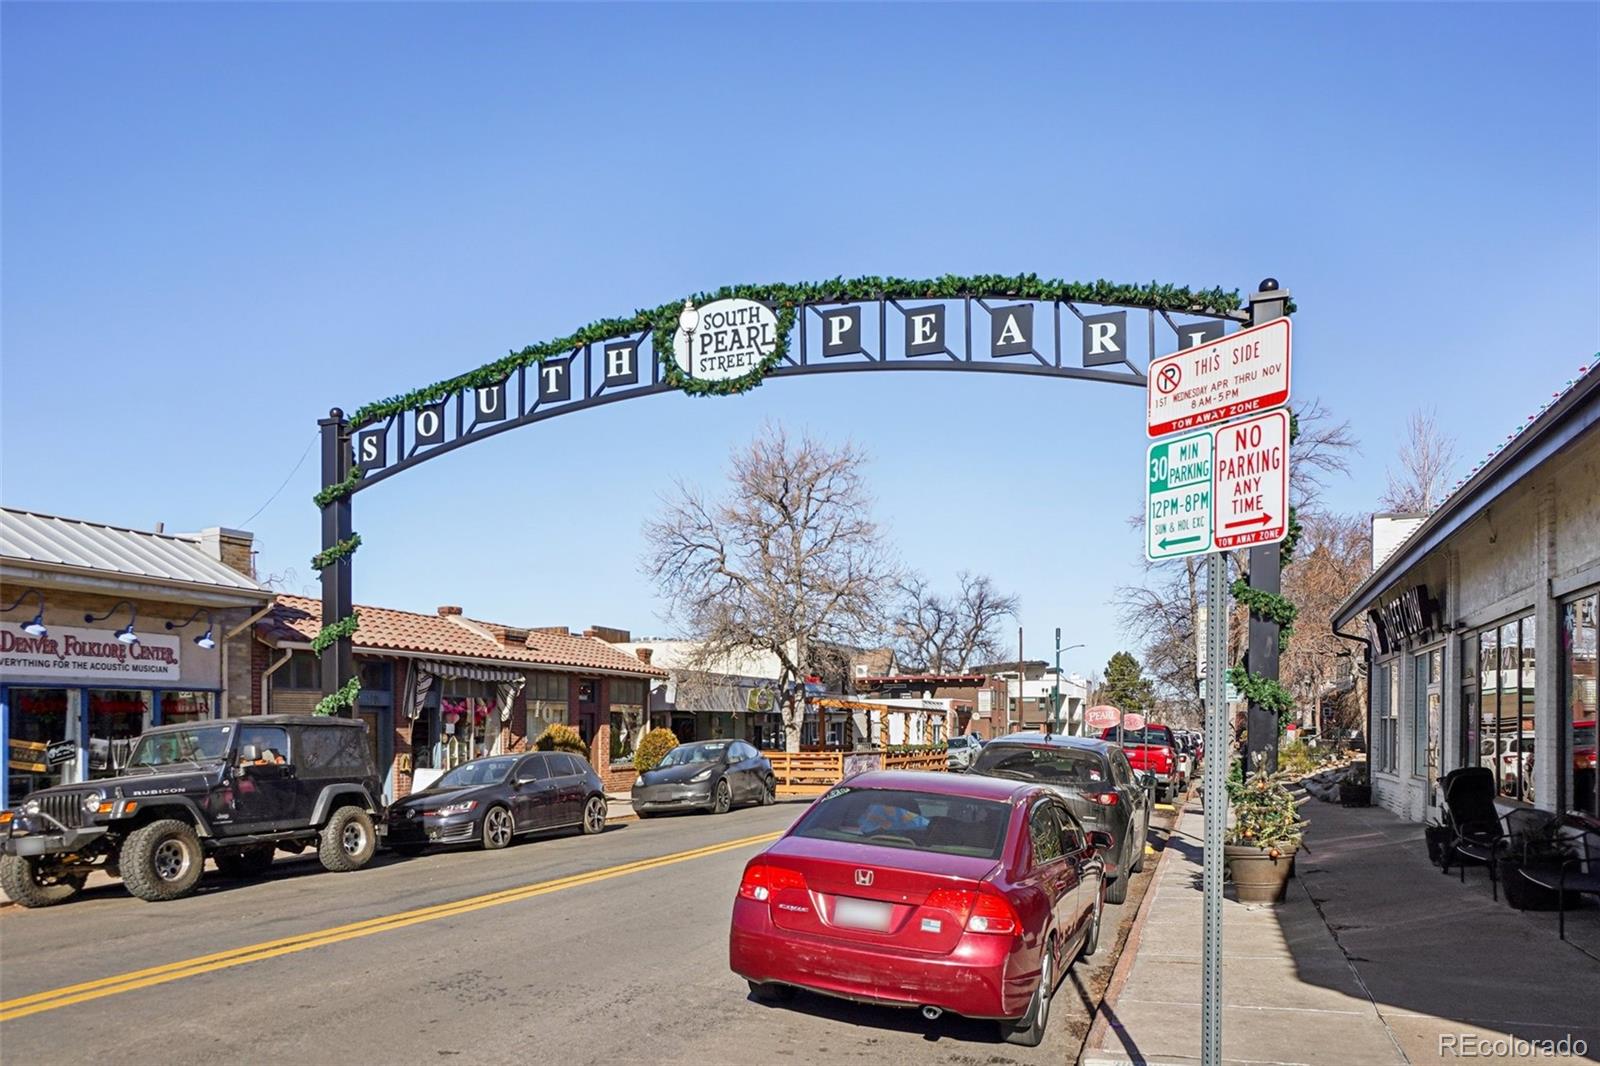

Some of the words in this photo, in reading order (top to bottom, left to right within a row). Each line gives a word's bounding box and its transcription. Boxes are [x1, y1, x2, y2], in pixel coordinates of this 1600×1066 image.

[703, 306, 760, 331] SOUTH
[699, 323, 776, 356] PEARL
[700, 352, 755, 373] STREET
[1194, 354, 1220, 376] THIS
[1232, 341, 1260, 365] SIDE
[1155, 397, 1168, 409] 1ST
[1173, 384, 1208, 403] WEDNESDAY
[1210, 379, 1229, 391] APR
[1234, 370, 1258, 385] THRU
[1262, 363, 1282, 377] NOV
[1171, 418, 1192, 430] TOW
[1195, 408, 1227, 424] AWAY
[1229, 399, 1260, 415] ZONE
[1235, 424, 1262, 451] NO
[1179, 442, 1199, 462] MIN
[1219, 447, 1280, 482] PARKING
[1150, 456, 1168, 483] 30
[1169, 460, 1209, 484] PARKING
[1233, 476, 1262, 497] ANY
[1152, 491, 1209, 519] 12PM-8PM
[1231, 495, 1264, 515] TIME
[1154, 523, 1167, 535] SUN
[1169, 522, 1175, 533] &
[1177, 519, 1189, 531] HOL
[1192, 516, 1205, 528] EXC
[1218, 537, 1233, 547] TOW
[1235, 533, 1256, 545] AWAY
[1259, 528, 1280, 541] ZONE
[0, 630, 65, 660] DENVER
[63, 635, 127, 663] FOLKLORE
[128, 640, 178, 665] CENTER
[53, 660, 70, 669] FOR
[73, 661, 88, 670] THE
[90, 662, 130, 672] ACOUSTIC
[132, 665, 169, 673] MUSICIAN
[133, 787, 186, 796] RUBICON
